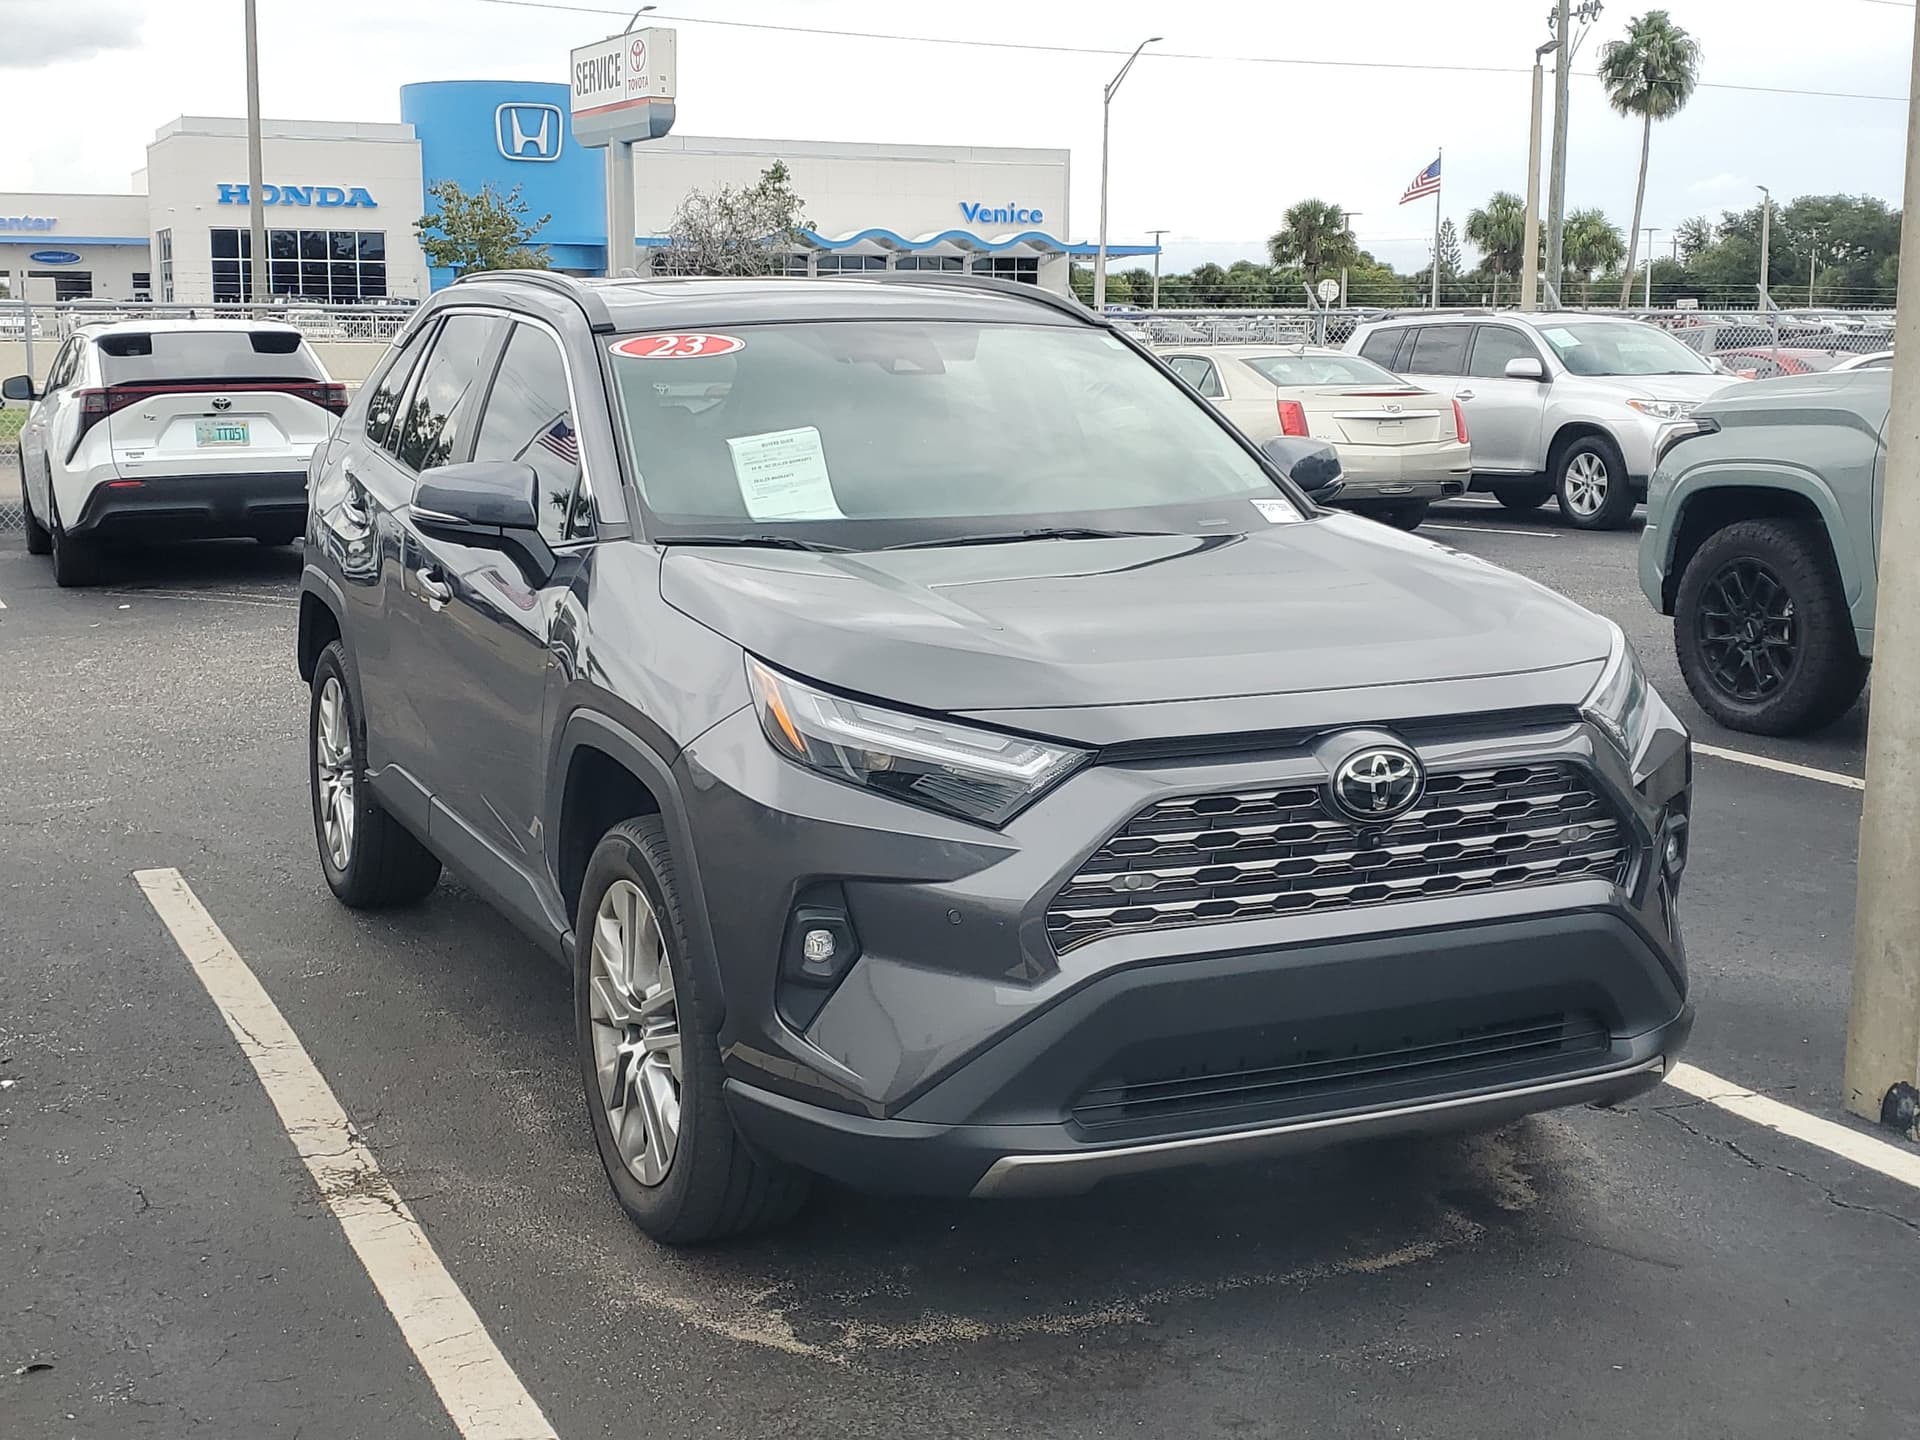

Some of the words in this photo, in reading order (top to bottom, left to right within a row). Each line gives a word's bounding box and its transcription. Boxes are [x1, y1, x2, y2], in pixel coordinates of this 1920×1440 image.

[576, 52, 621, 97] SERVICE
[628, 75, 649, 92] TOYOTA
[217, 184, 378, 208] HONDA
[959, 202, 1043, 224] Venice
[647, 336, 707, 356] 23
